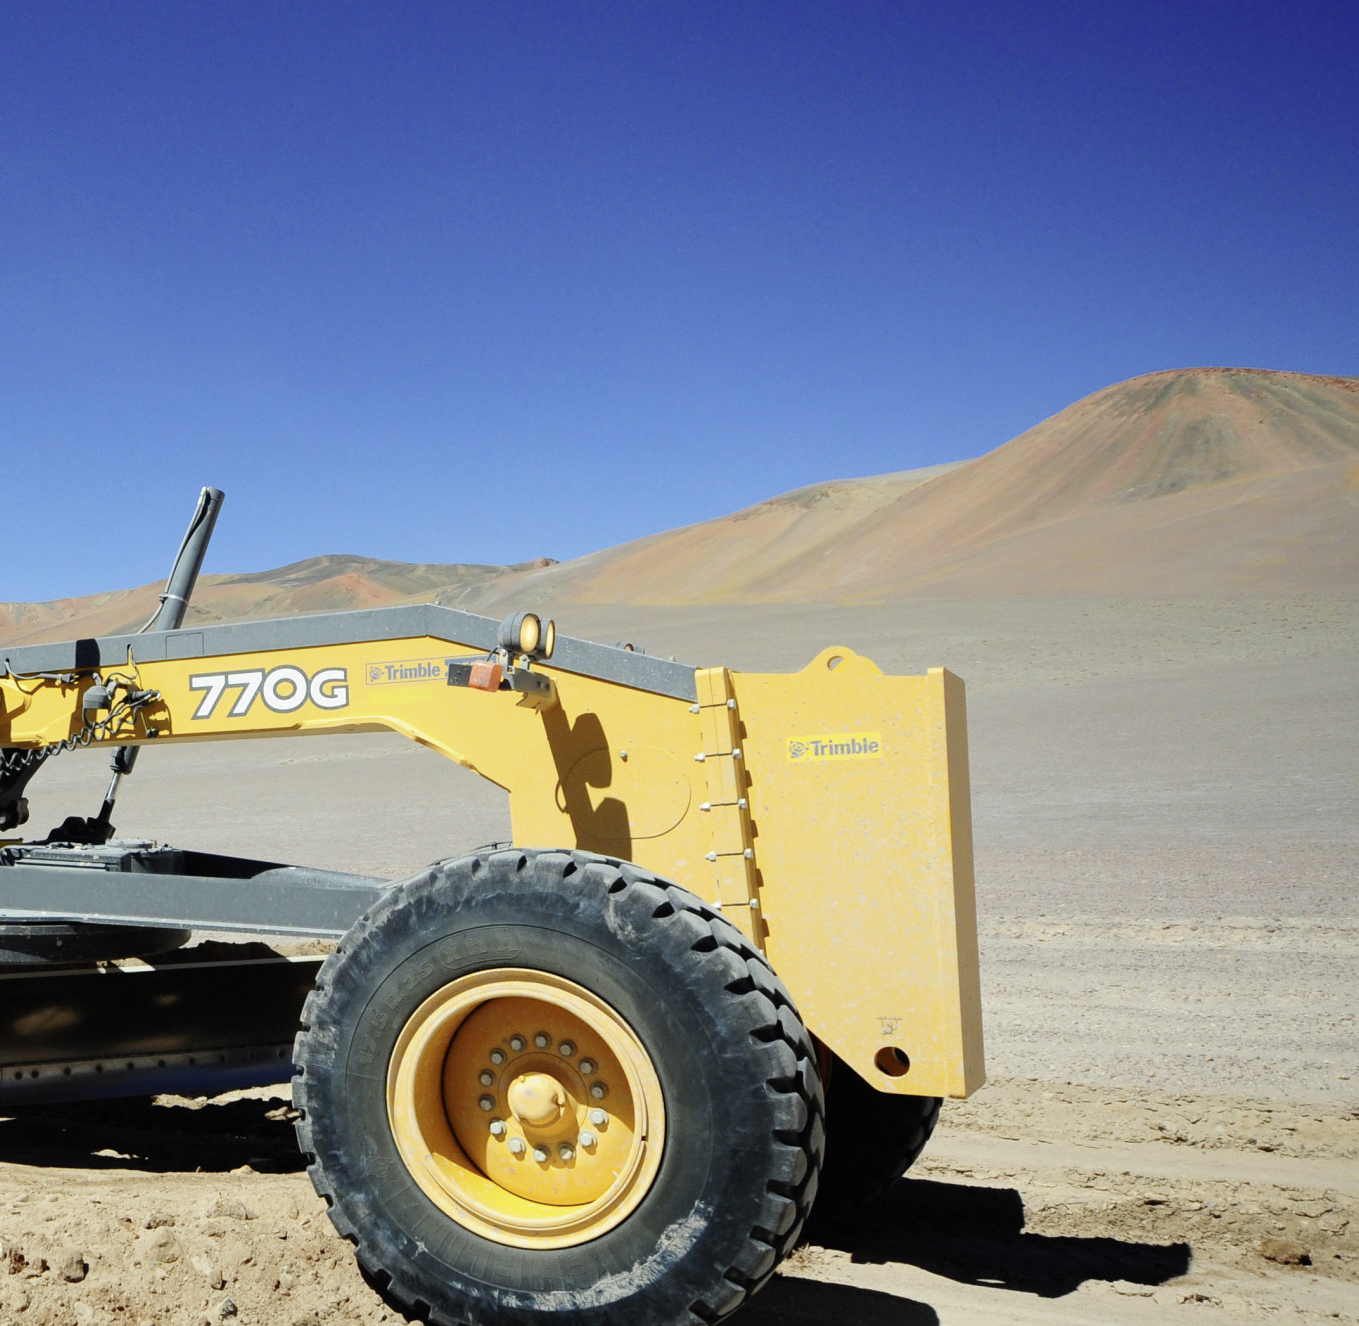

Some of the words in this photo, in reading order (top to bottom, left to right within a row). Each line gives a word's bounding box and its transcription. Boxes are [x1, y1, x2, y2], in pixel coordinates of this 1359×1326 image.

[384, 662, 441, 680] Trimble
[189, 666, 348, 719] 770G
[810, 738, 879, 756] Trimble
